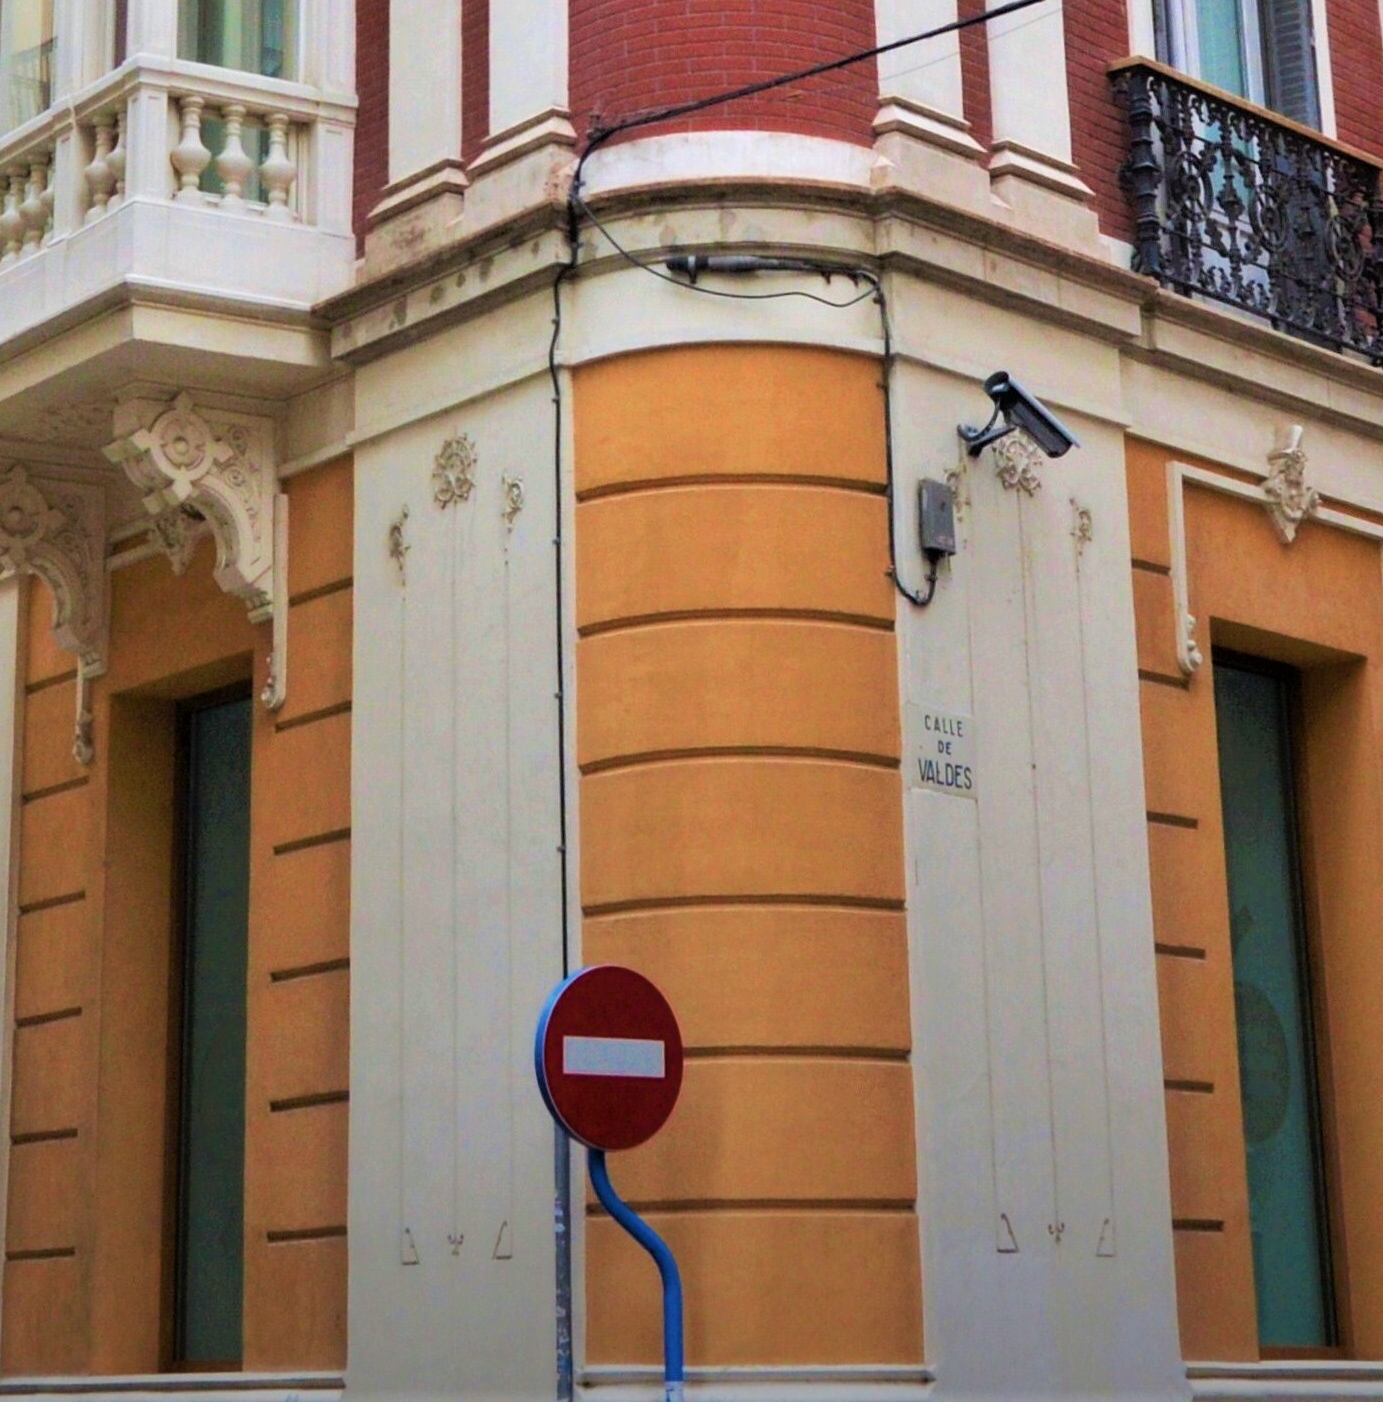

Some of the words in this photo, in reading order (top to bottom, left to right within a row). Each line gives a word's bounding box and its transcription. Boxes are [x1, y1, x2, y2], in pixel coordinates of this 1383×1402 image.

[924, 714, 964, 737] CALLE
[937, 739, 952, 755] DE
[918, 757, 973, 790] VALDES
